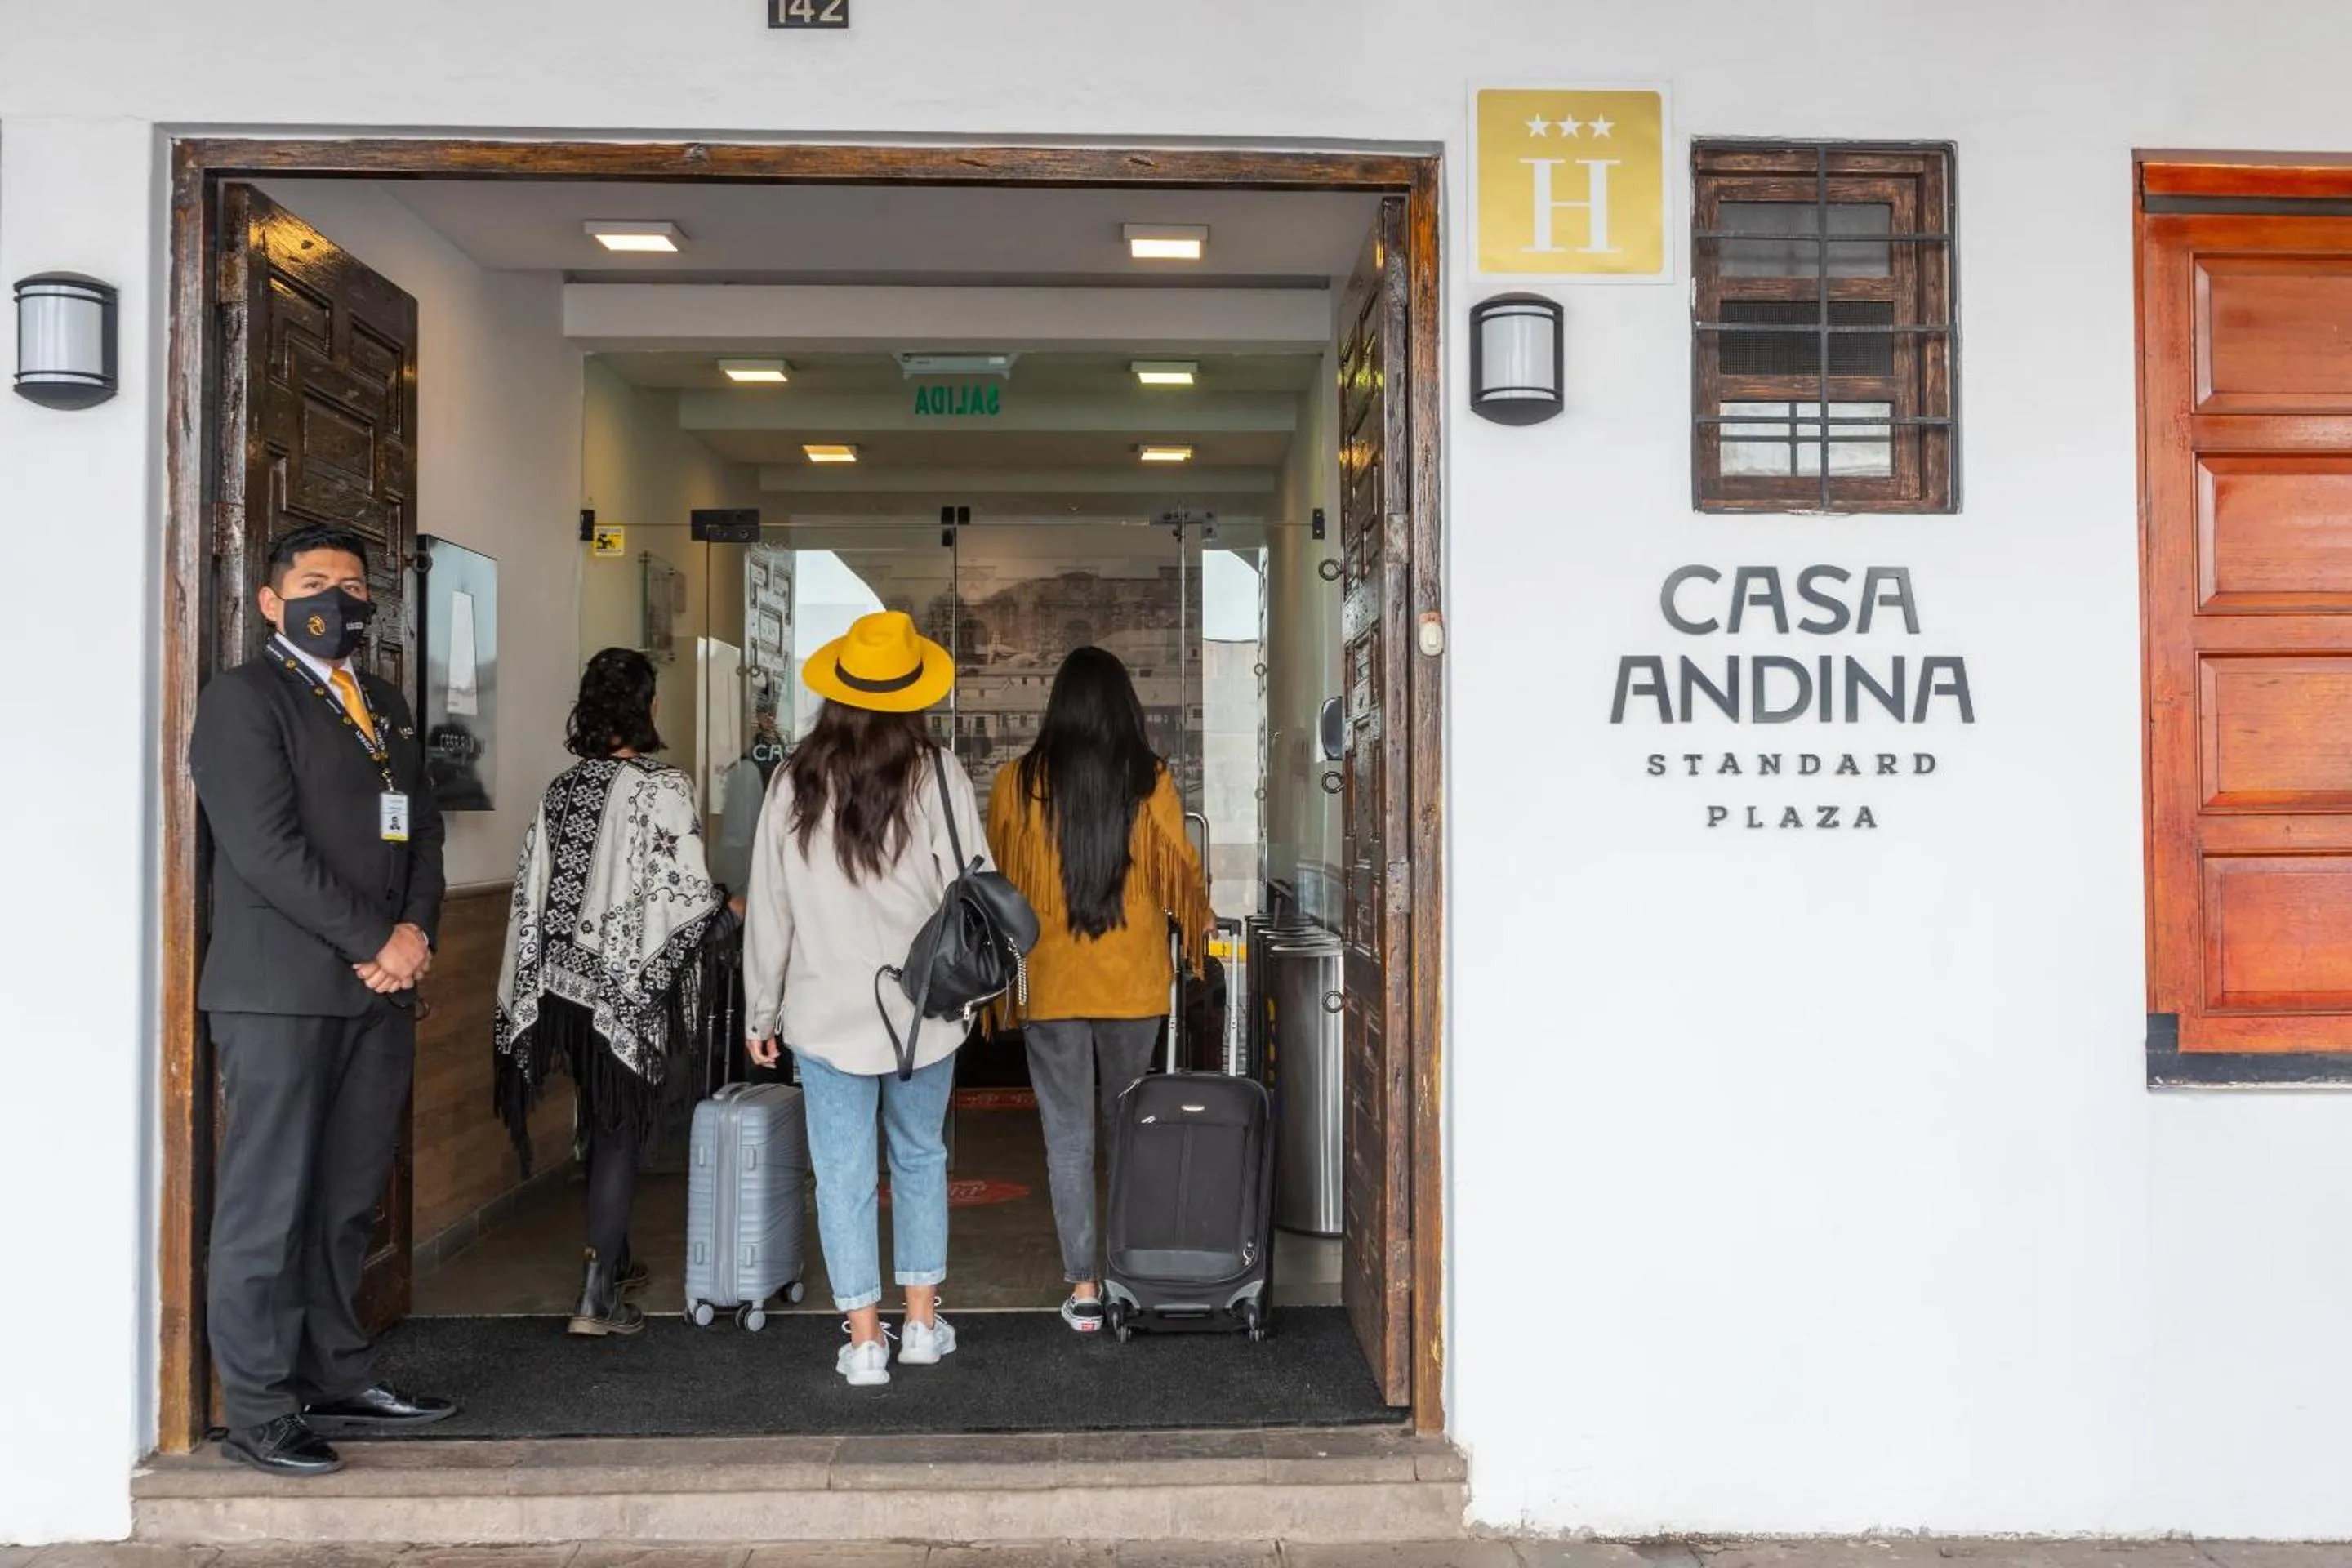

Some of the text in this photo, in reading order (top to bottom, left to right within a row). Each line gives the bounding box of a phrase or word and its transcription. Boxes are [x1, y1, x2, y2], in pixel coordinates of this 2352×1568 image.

[1519, 158, 1622, 253] H
[1660, 564, 1921, 635] CASA
[1610, 655, 1976, 724] ANDINA
[1646, 753, 1936, 776] STANDARD
[1707, 806, 1878, 829] PLAZA
